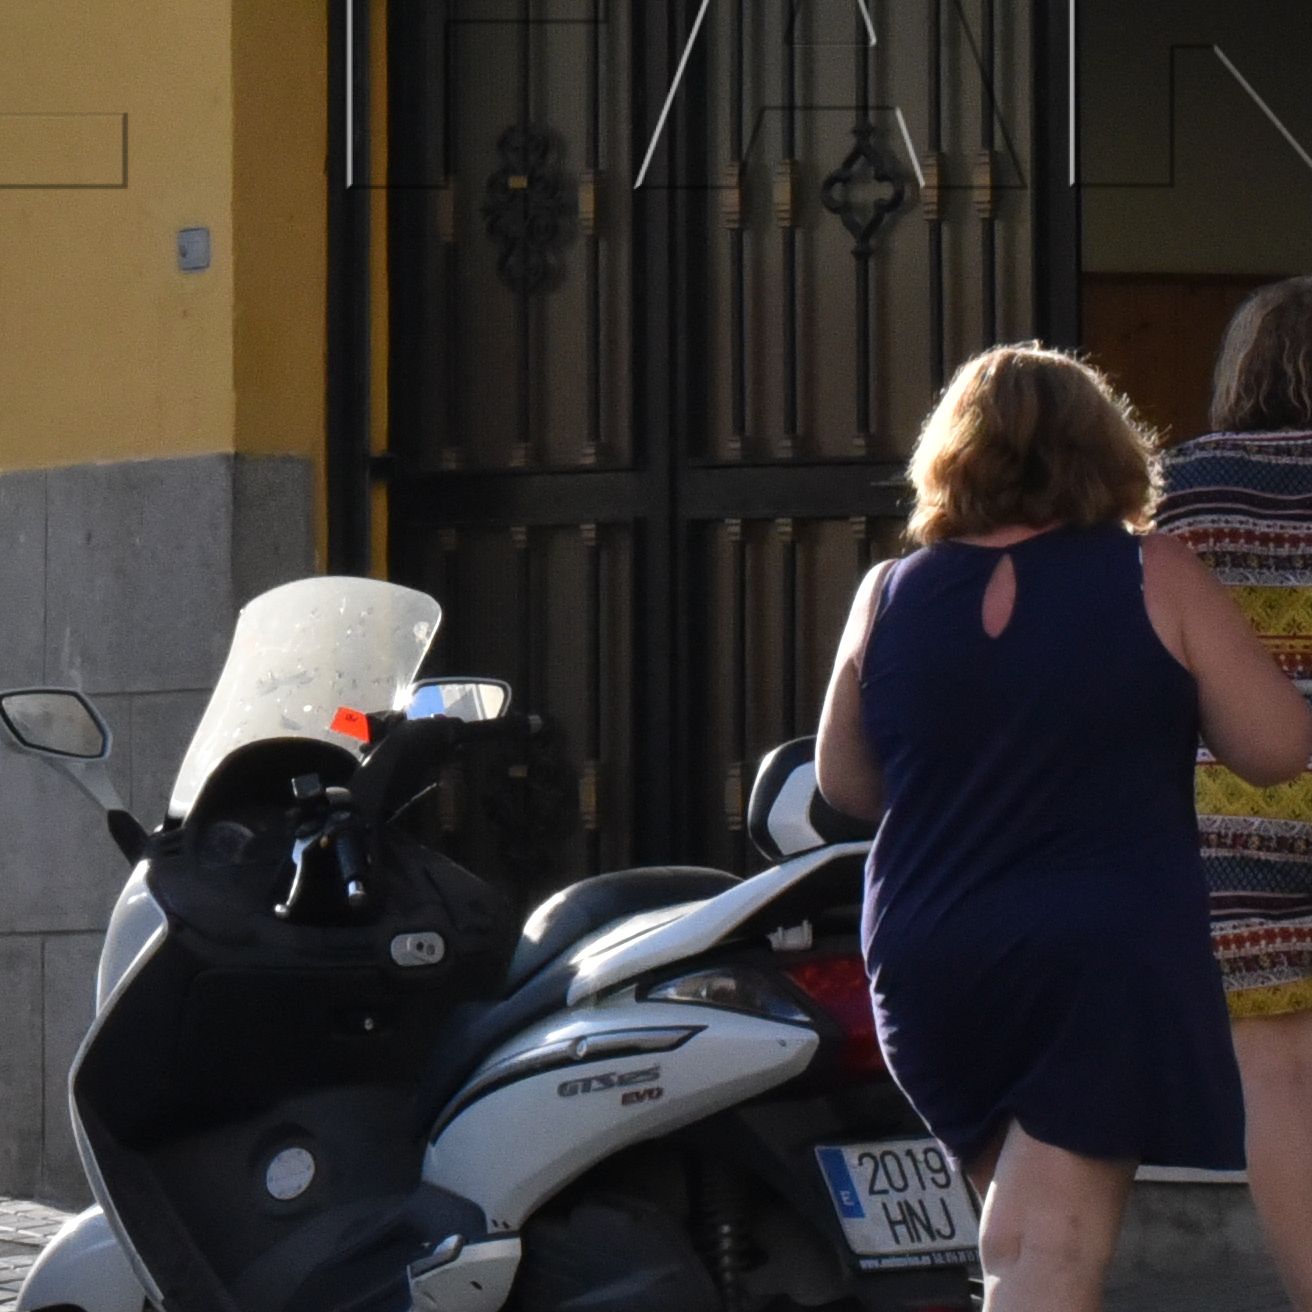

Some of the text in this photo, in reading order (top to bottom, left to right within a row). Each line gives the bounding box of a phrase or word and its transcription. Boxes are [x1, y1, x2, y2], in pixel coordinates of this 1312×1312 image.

[839, 1147, 952, 1206] E 2019
[882, 1198, 956, 1245] HNJ
